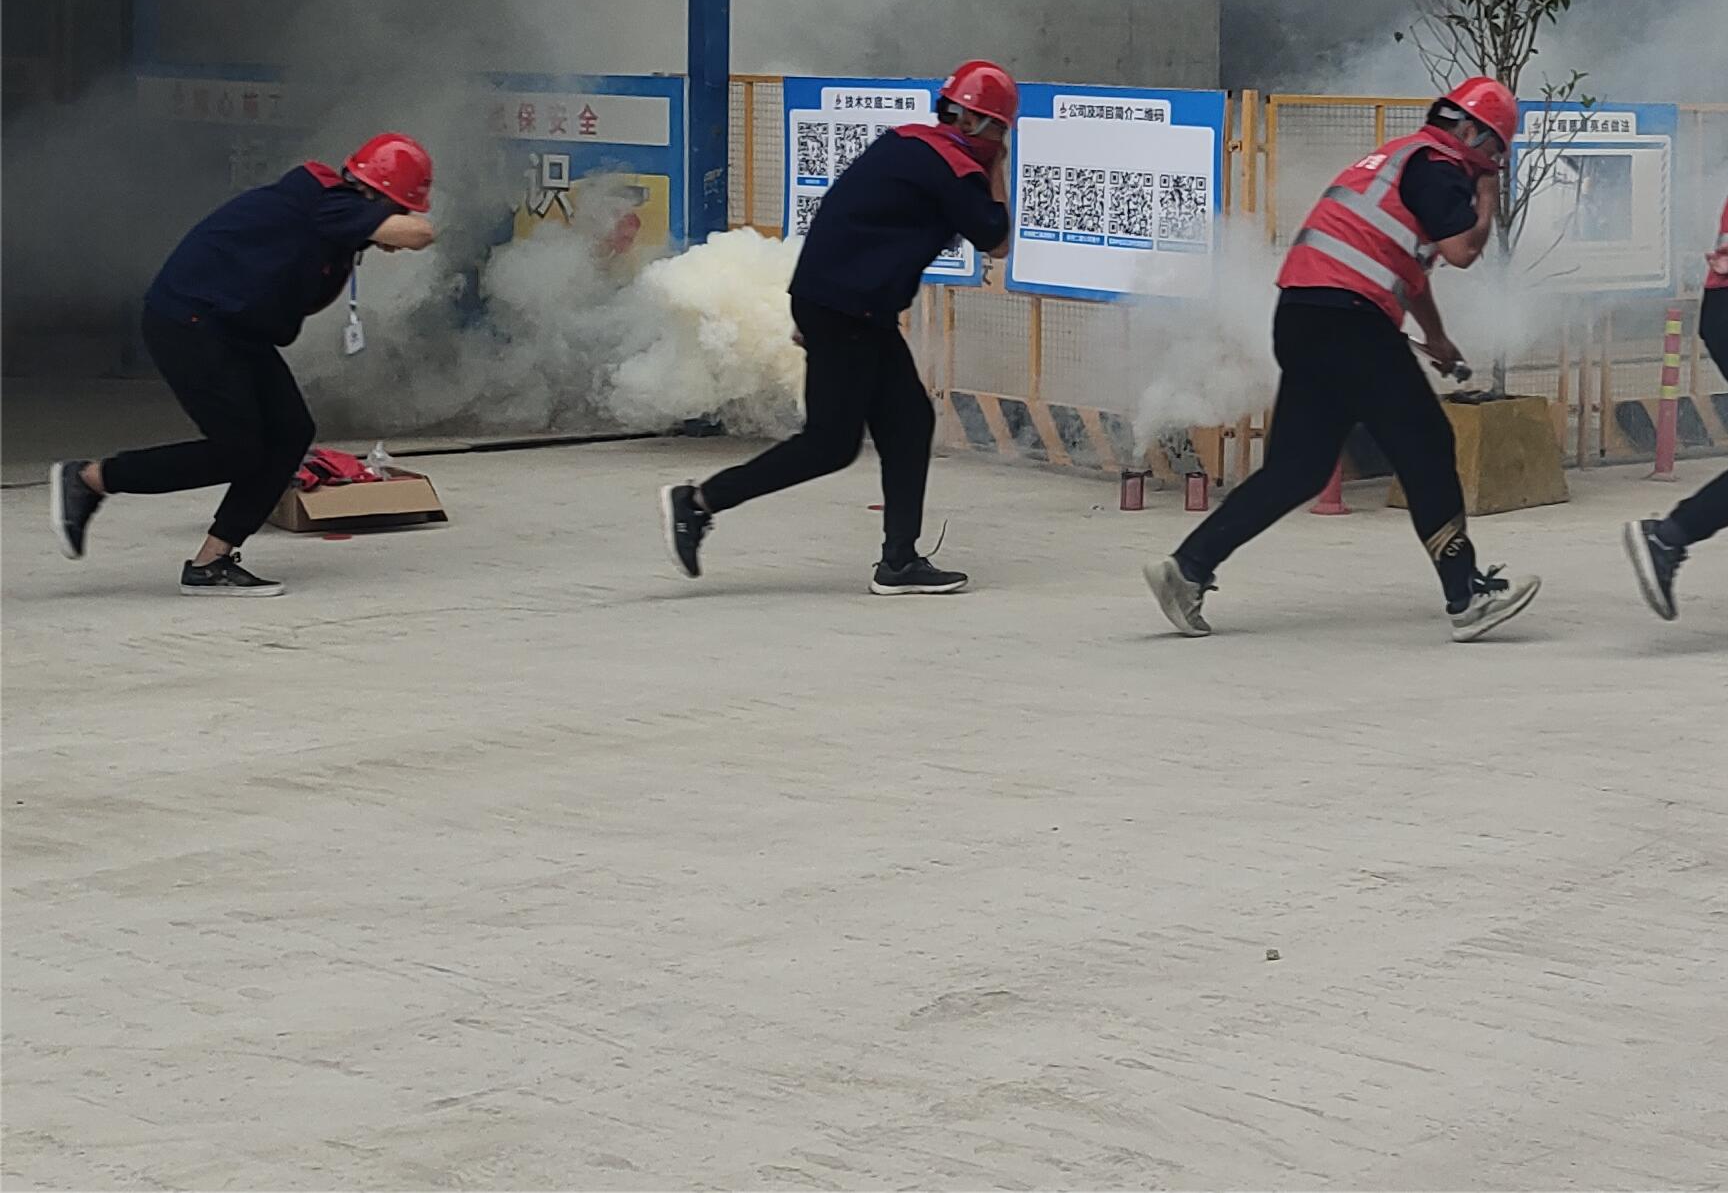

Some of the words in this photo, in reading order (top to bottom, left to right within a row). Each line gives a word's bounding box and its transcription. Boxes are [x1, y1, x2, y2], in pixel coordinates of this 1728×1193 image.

[845, 95, 916, 111] 技术交底二维码
[1068, 103, 1165, 124] 公司及项目简介二维码
